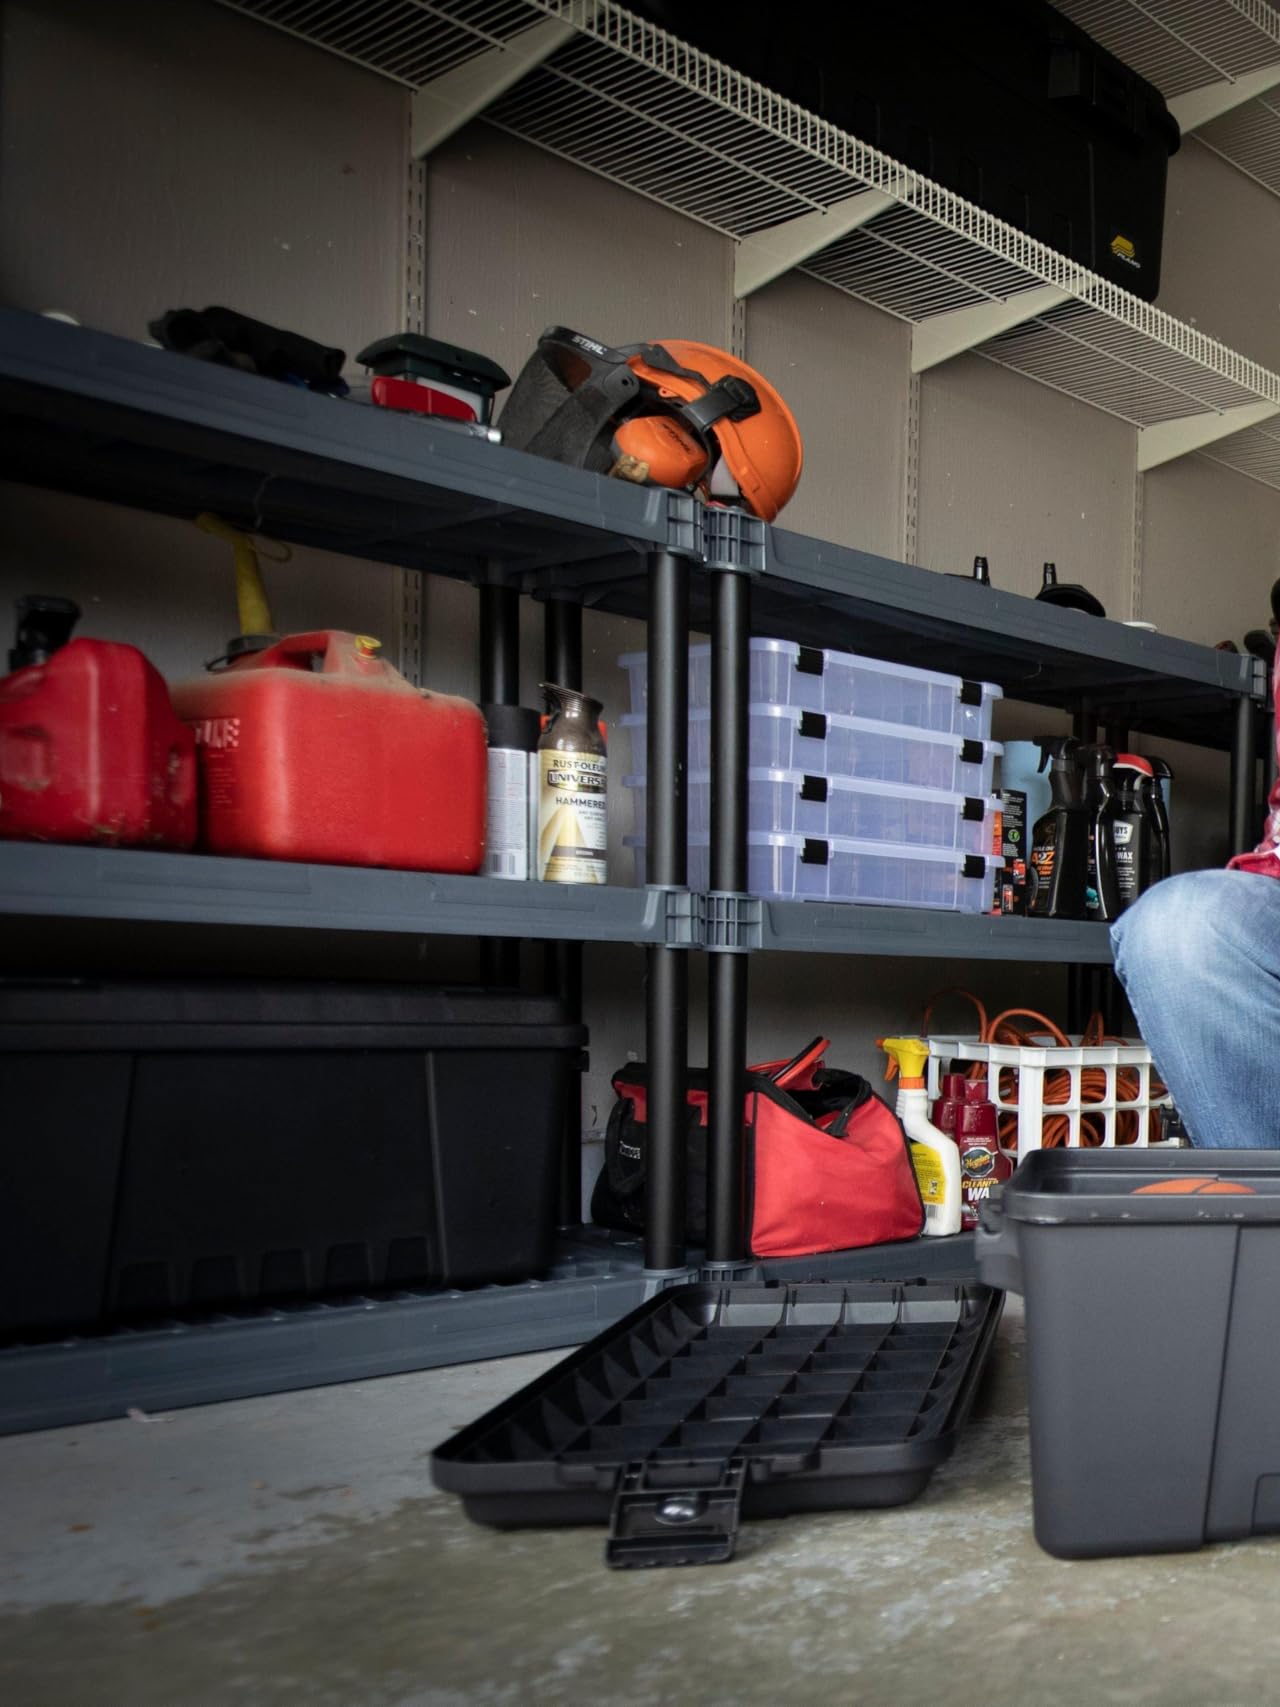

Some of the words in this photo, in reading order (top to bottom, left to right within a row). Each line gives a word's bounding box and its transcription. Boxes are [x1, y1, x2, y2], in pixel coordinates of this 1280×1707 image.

[571, 335, 605, 356] STIHL
[550, 771, 607, 785] UNIVERS
[967, 1188, 991, 1202] WA
